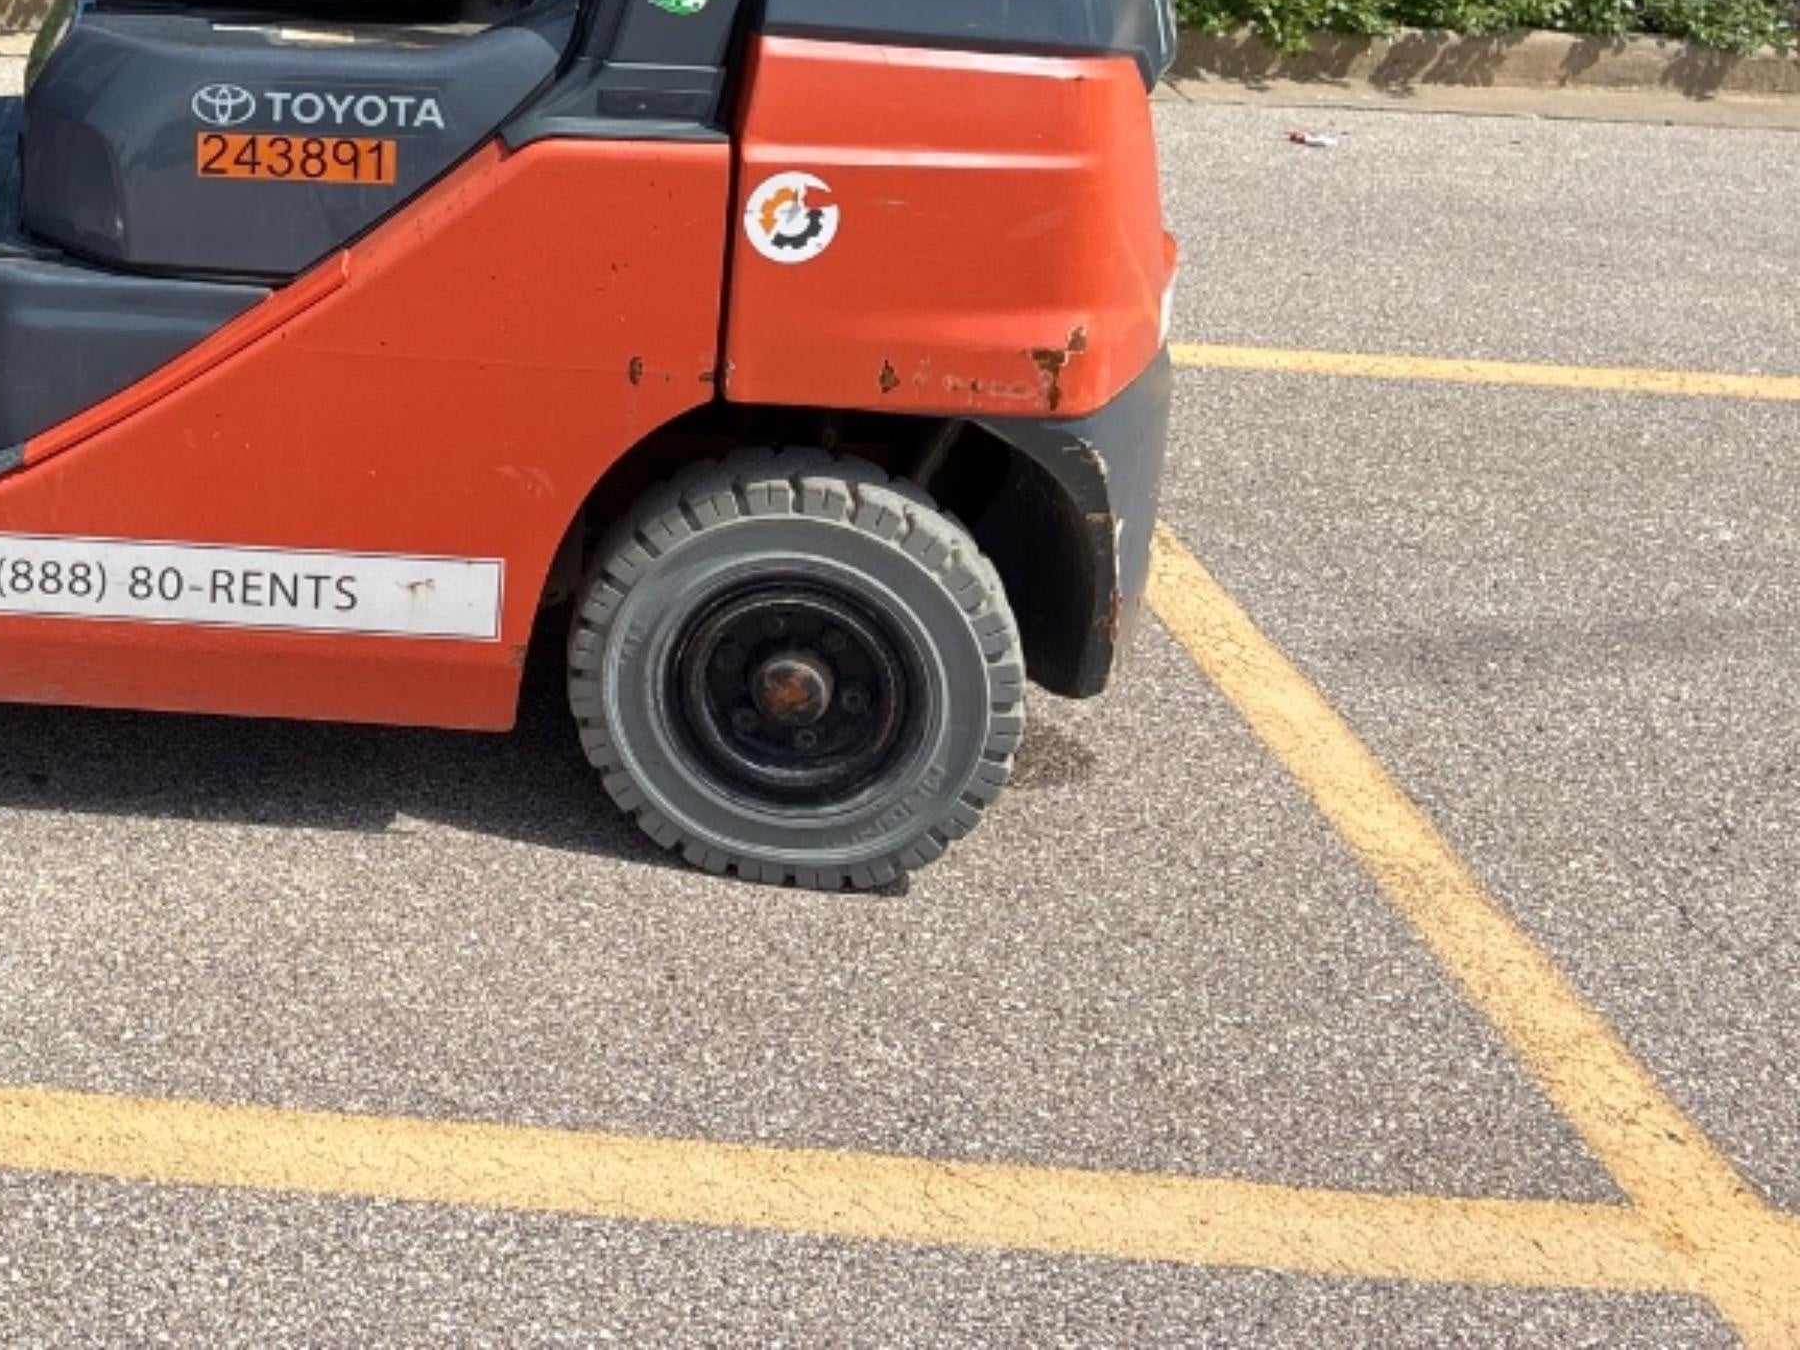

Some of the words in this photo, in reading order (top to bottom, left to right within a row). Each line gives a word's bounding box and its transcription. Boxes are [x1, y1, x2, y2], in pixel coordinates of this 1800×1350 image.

[264, 91, 445, 129] TOYOTA
[200, 134, 384, 180] 243891
[128, 565, 359, 612] 80-RENTS
